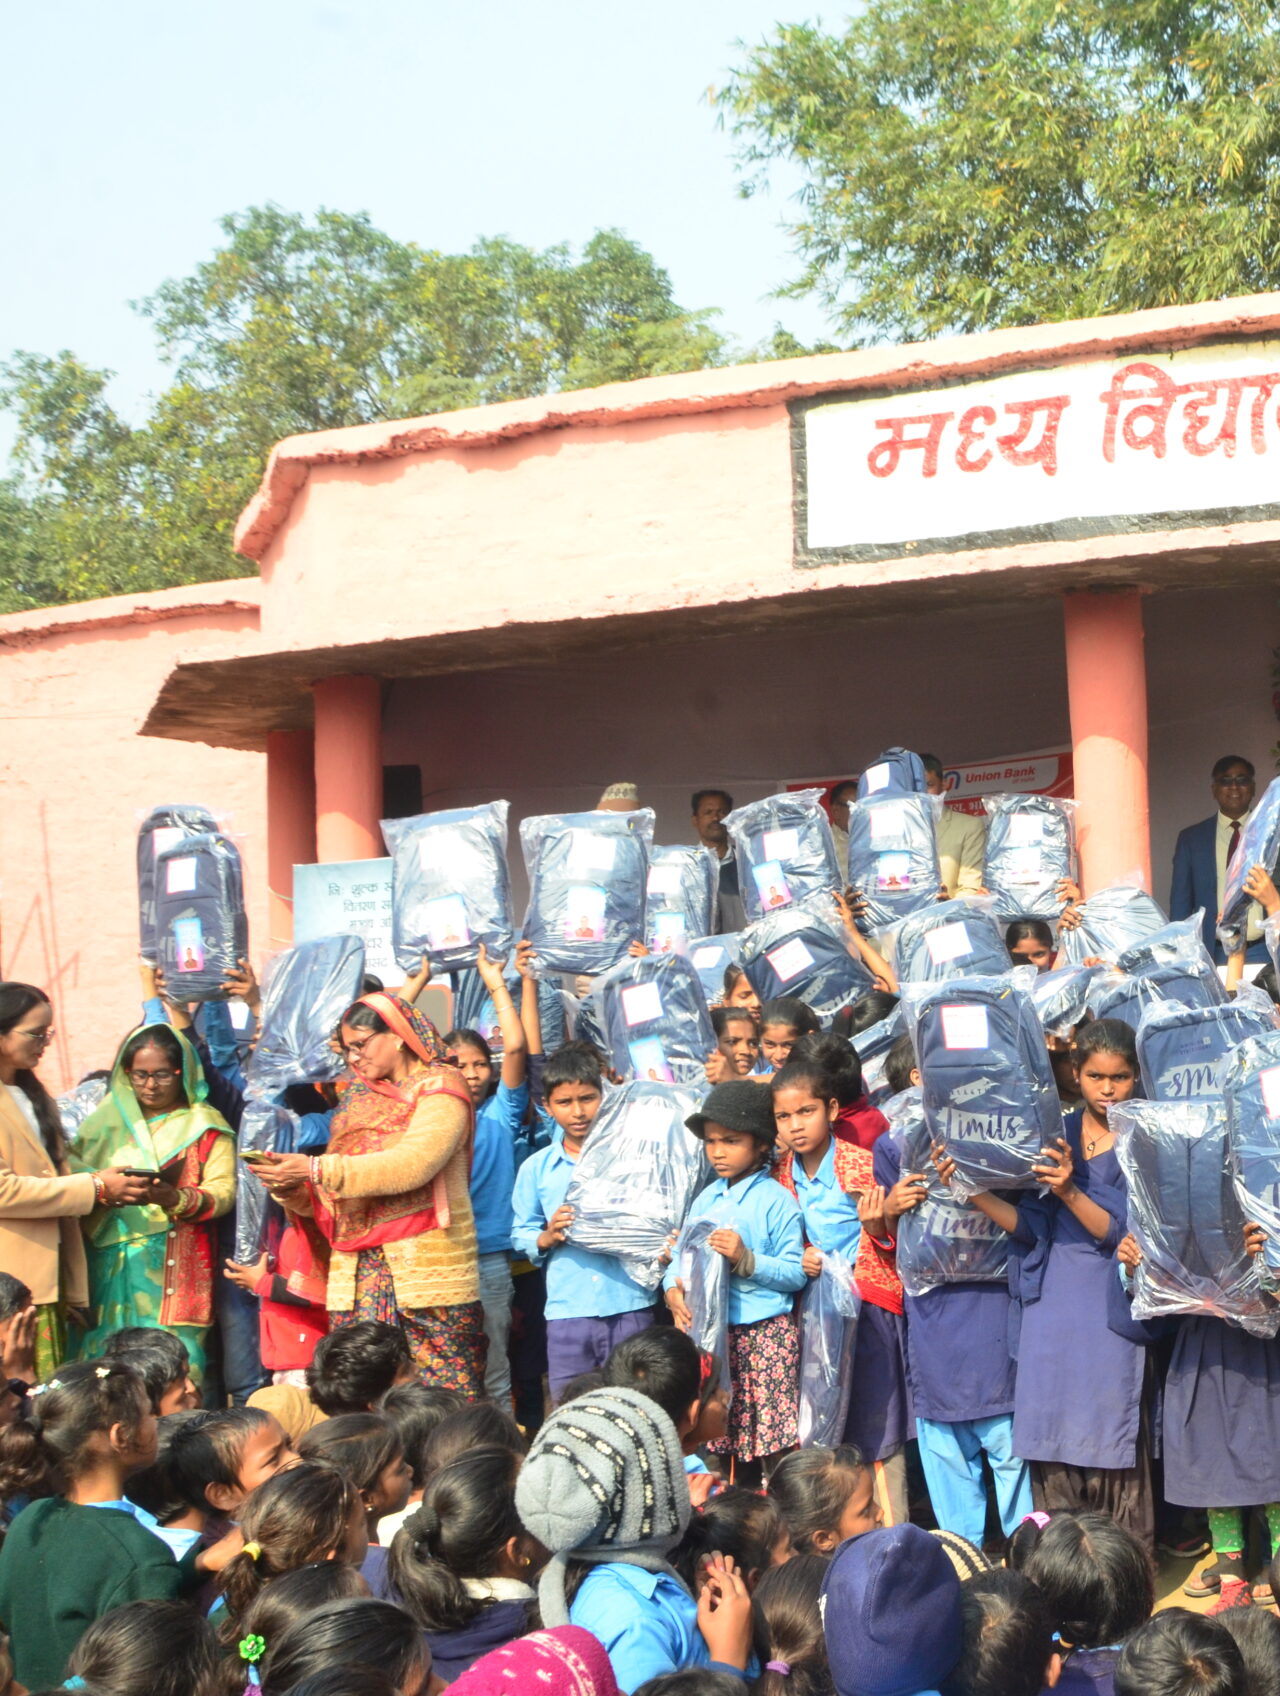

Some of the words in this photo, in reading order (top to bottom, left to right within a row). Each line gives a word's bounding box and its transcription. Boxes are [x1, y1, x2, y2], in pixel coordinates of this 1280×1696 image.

[867, 395, 1072, 478] मध्य
[965, 771, 1001, 784] Union
[1004, 765, 1036, 779] Bank
[343, 899, 376, 912] वितरण
[946, 1104, 1021, 1142] Limits
